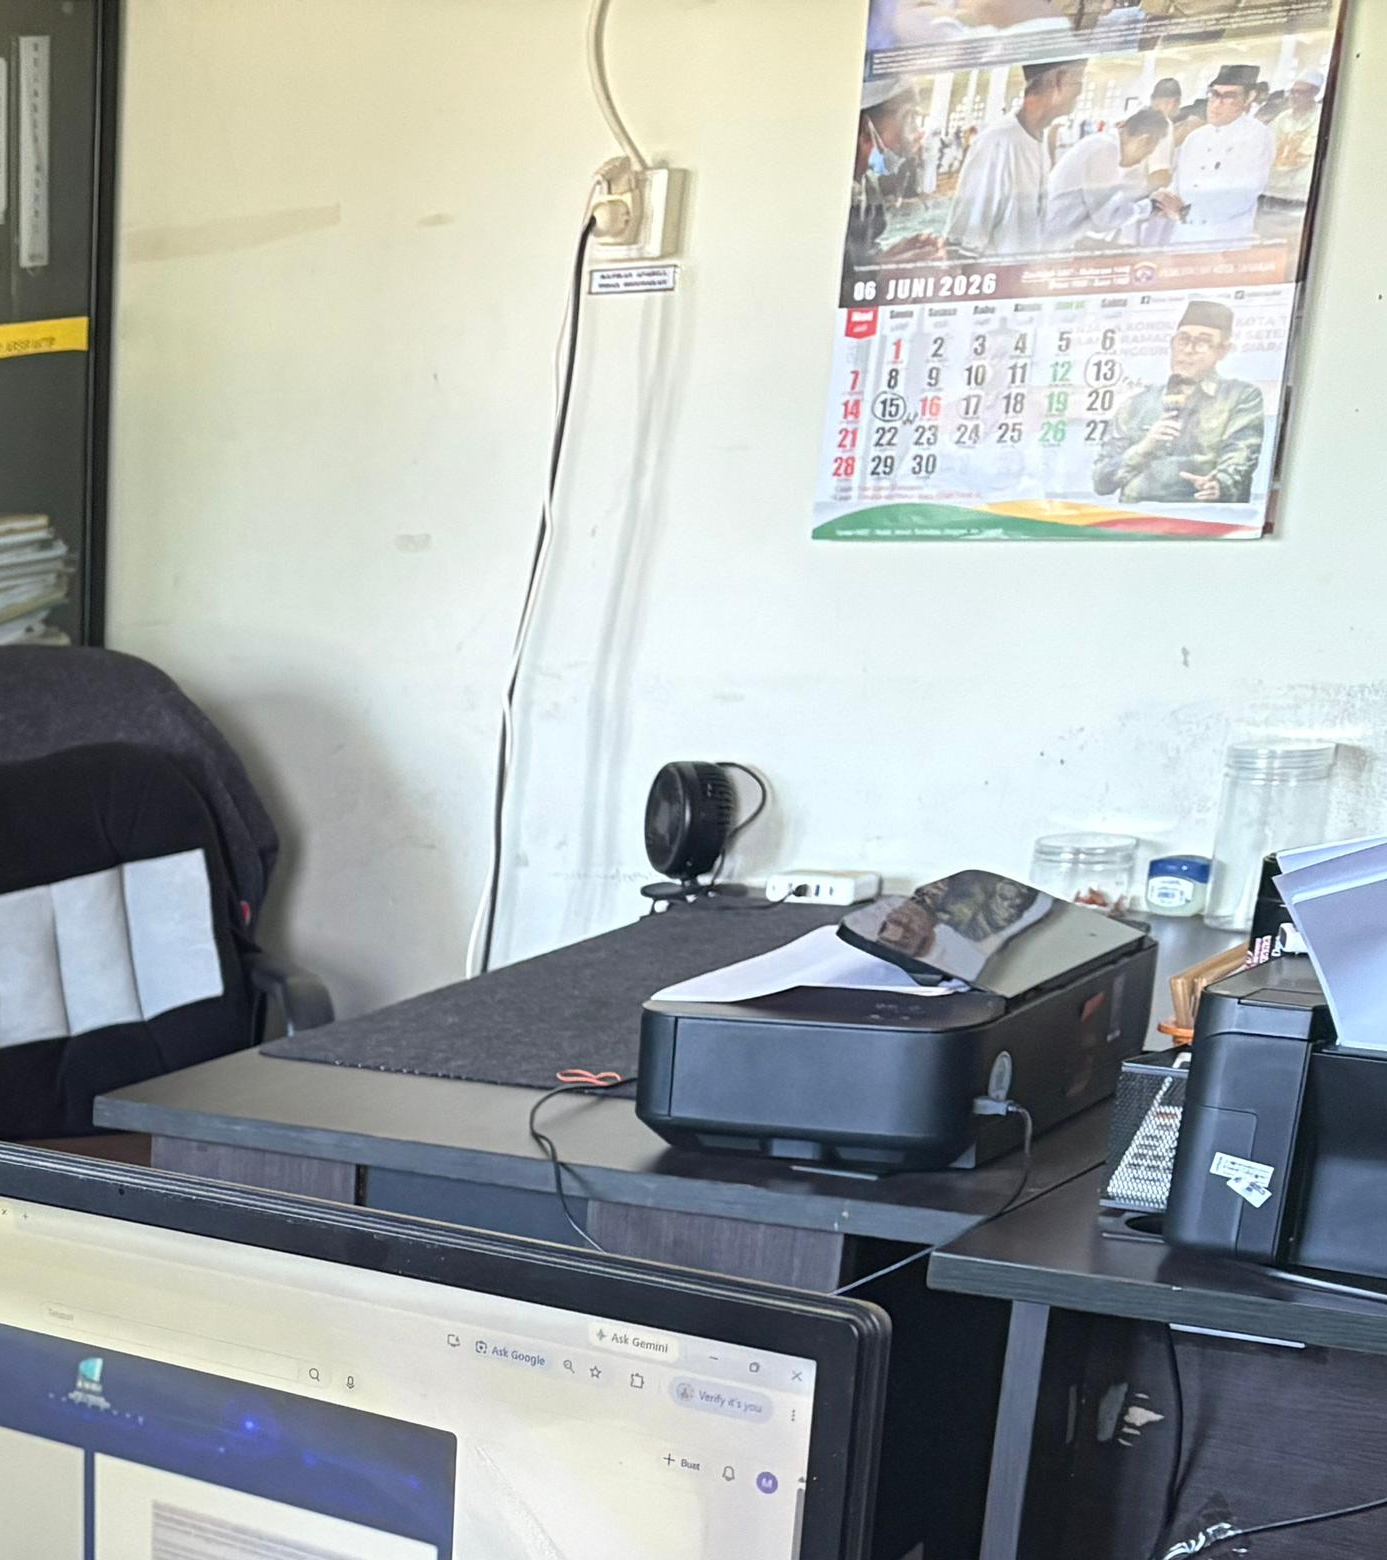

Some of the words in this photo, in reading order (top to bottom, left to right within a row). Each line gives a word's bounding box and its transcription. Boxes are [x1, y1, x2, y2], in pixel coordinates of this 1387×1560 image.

[853, 281, 877, 301] 06
[886, 277, 935, 300] JUNI
[939, 273, 997, 297] 2026
[893, 339, 903, 360] 1
[931, 336, 945, 358] 2
[973, 334, 986, 356] 3
[1014, 333, 1027, 354] 4
[1058, 331, 1071, 351] 5
[1102, 329, 1116, 350] 6
[850, 370, 860, 391] 7
[887, 368, 899, 389] 8
[927, 366, 940, 387] 9
[965, 364, 986, 386] 10
[1008, 362, 1028, 384] 11
[1051, 361, 1072, 382] 12
[1093, 359, 1116, 382] 13
[842, 400, 860, 419] 14
[880, 398, 900, 418] 15
[921, 396, 941, 417] 16
[964, 395, 982, 415] 17
[1003, 393, 1024, 414] 18
[1047, 391, 1068, 413] 19
[1086, 390, 1114, 411] 20
[838, 428, 858, 448] 21
[874, 427, 898, 447] 22
[914, 425, 939, 446] 23
[955, 424, 980, 445] 24
[997, 423, 1022, 443] 25
[1039, 421, 1067, 442] 26
[1085, 420, 1109, 441] 27
[833, 456, 855, 477] 28
[871, 455, 894, 476] 29
[912, 454, 936, 475] 30
[491, 1346, 509, 1359] Ask
[511, 1350, 546, 1367] Google
[612, 1332, 629, 1345] Ask
[632, 1336, 669, 1353] Gemini
[698, 1389, 725, 1407] Verify
